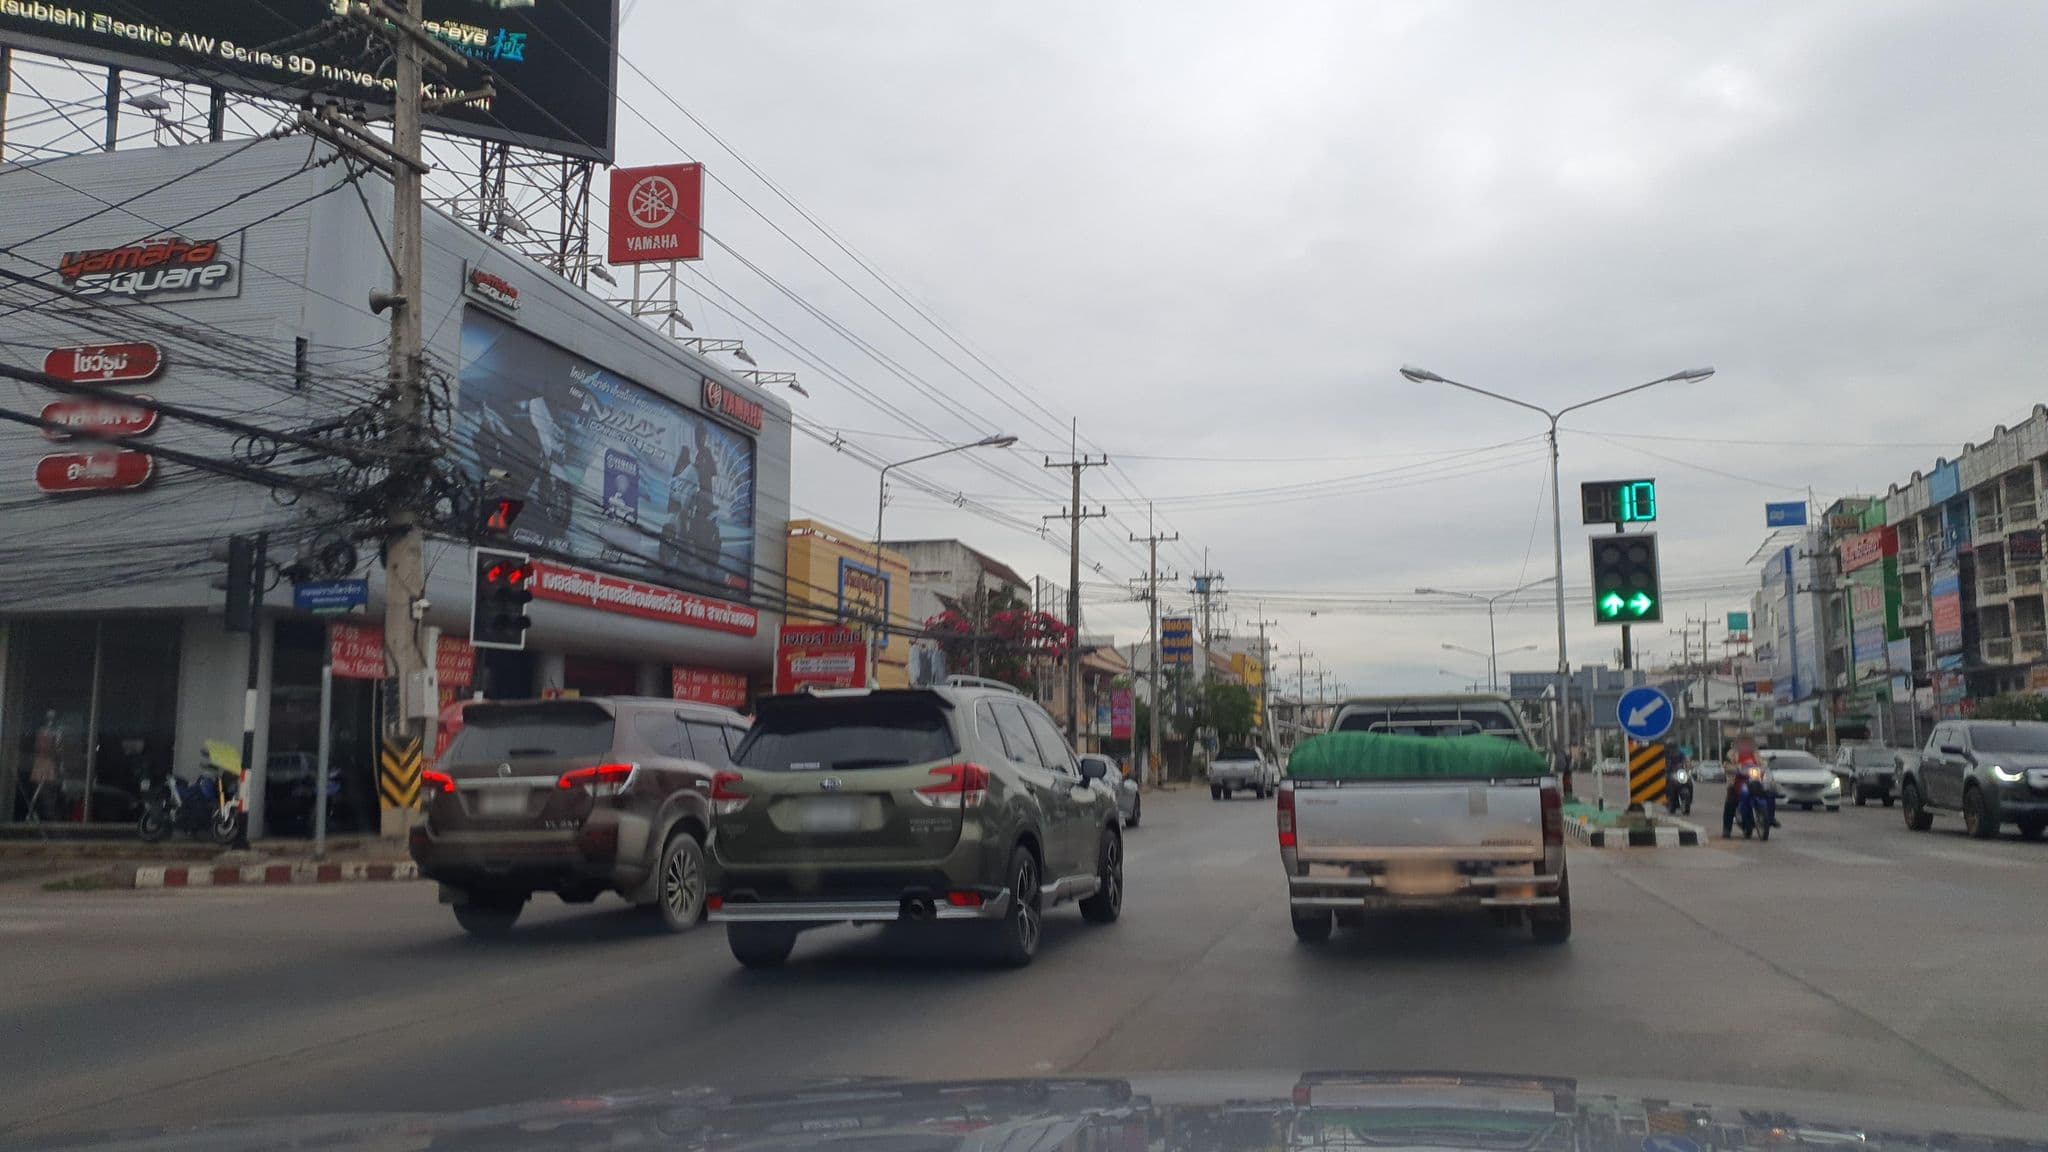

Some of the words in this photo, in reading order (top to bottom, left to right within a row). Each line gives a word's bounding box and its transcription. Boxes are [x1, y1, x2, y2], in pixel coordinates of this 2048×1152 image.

[92, 12, 174, 47] Electric
[179, 31, 216, 55] AW
[220, 40, 284, 70] Series
[288, 55, 317, 76] 3D
[626, 233, 679, 251] YAMAHA
[722, 388, 764, 431] YAMAHA
[1622, 482, 1656, 521] 10
